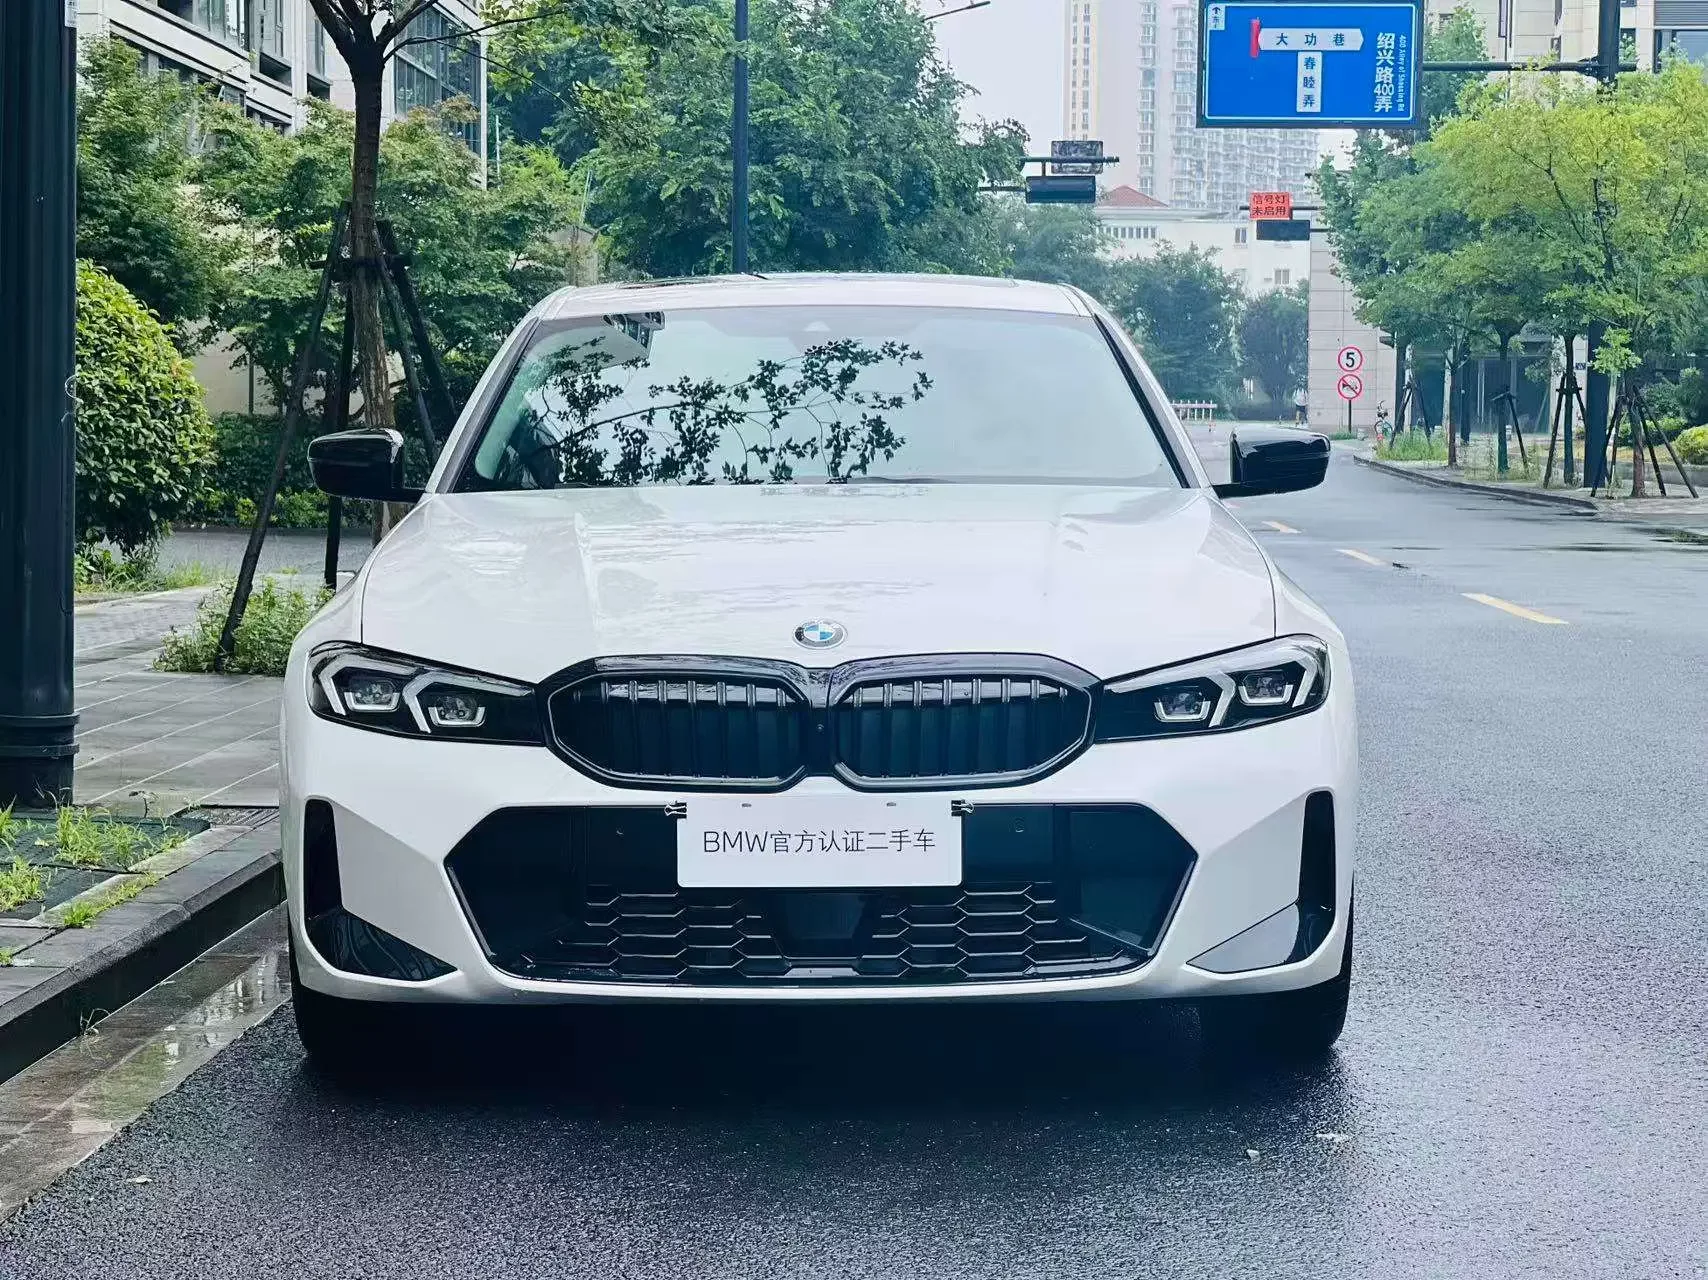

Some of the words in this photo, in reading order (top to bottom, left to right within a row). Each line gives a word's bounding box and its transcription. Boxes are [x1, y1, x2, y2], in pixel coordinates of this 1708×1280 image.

[1276, 33, 1345, 46] 大功巷
[1374, 32, 1395, 112] 绍兴路400弄
[1303, 57, 1316, 107] 春睦弄
[1253, 194, 1286, 205] 信号灯
[1252, 206, 1286, 216] 未启用
[1345, 352, 1355, 368] 5
[703, 829, 936, 853] BMW官方认证二手车
